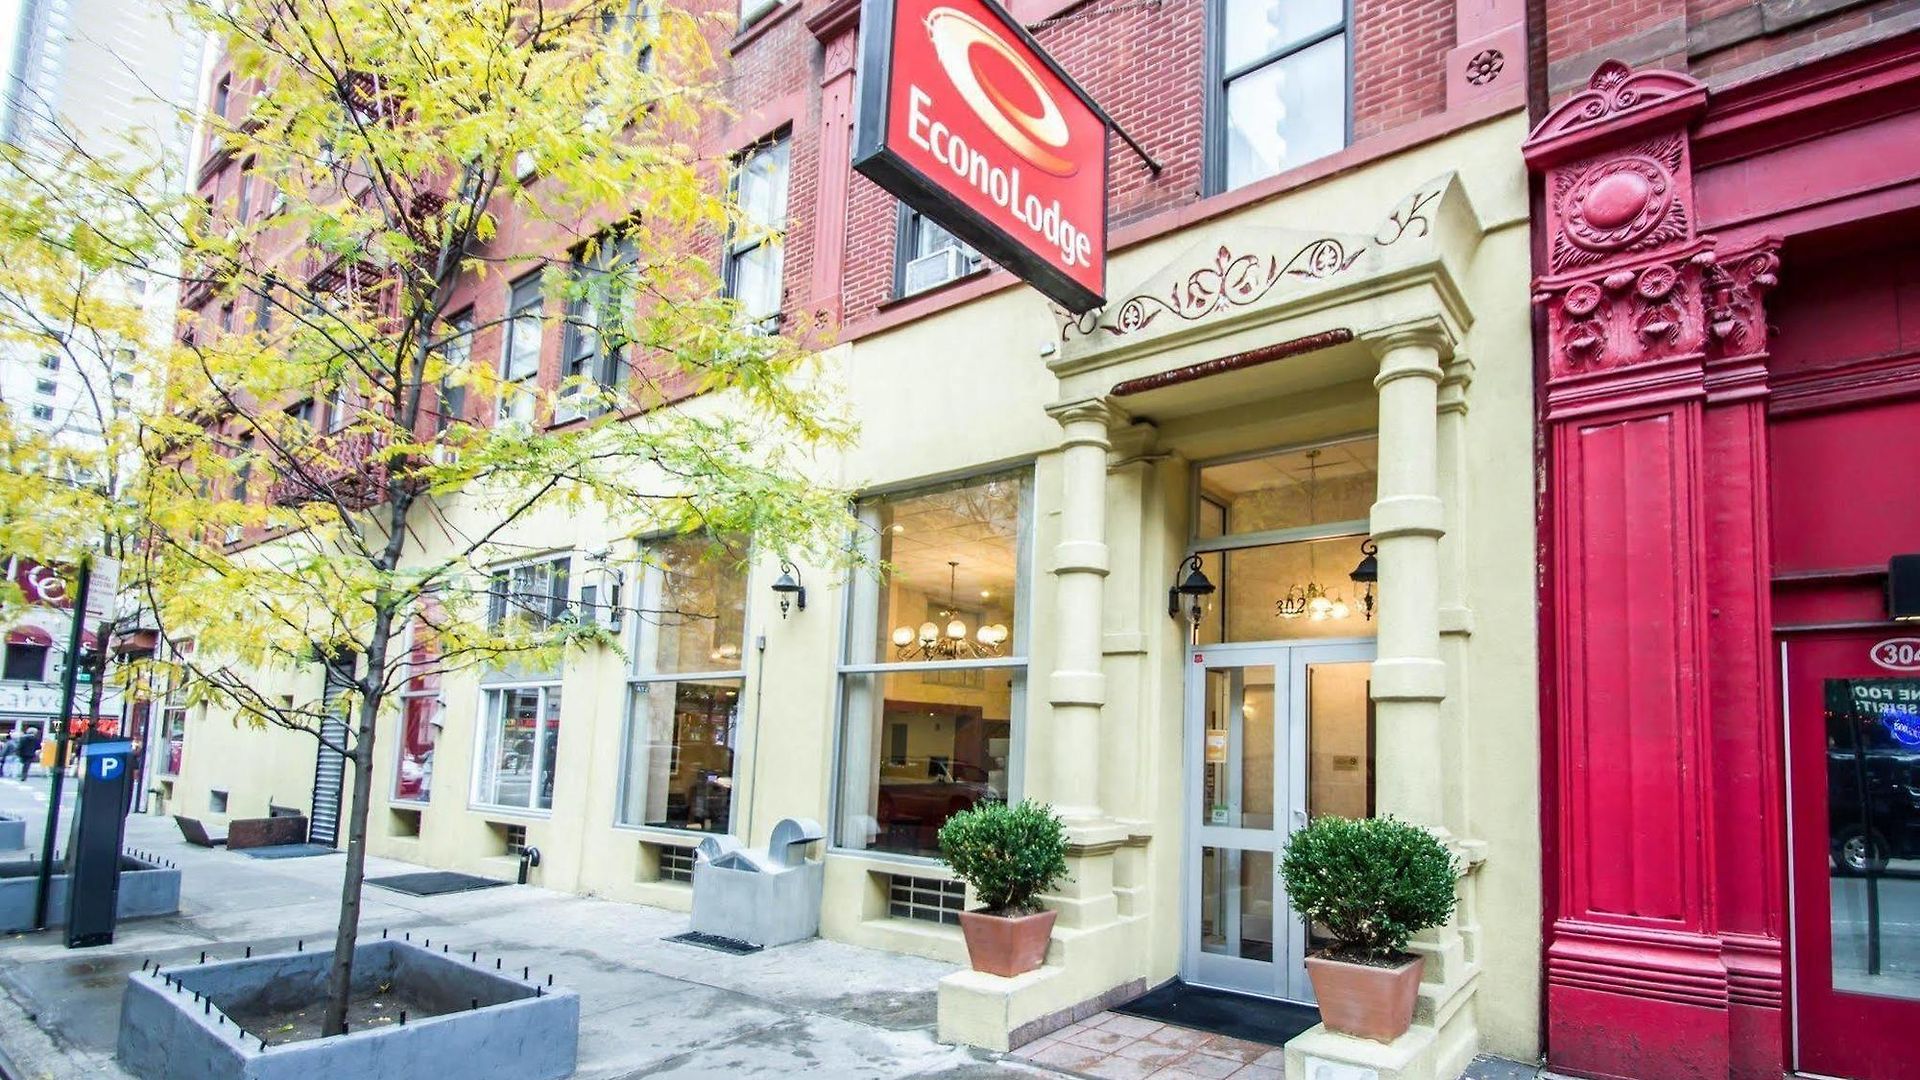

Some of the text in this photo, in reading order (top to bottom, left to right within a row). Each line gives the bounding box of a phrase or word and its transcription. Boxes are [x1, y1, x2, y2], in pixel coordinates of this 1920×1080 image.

[907, 84, 1092, 269] EconoLodge
[1275, 597, 1306, 617] 302
[101, 757, 118, 777] P
